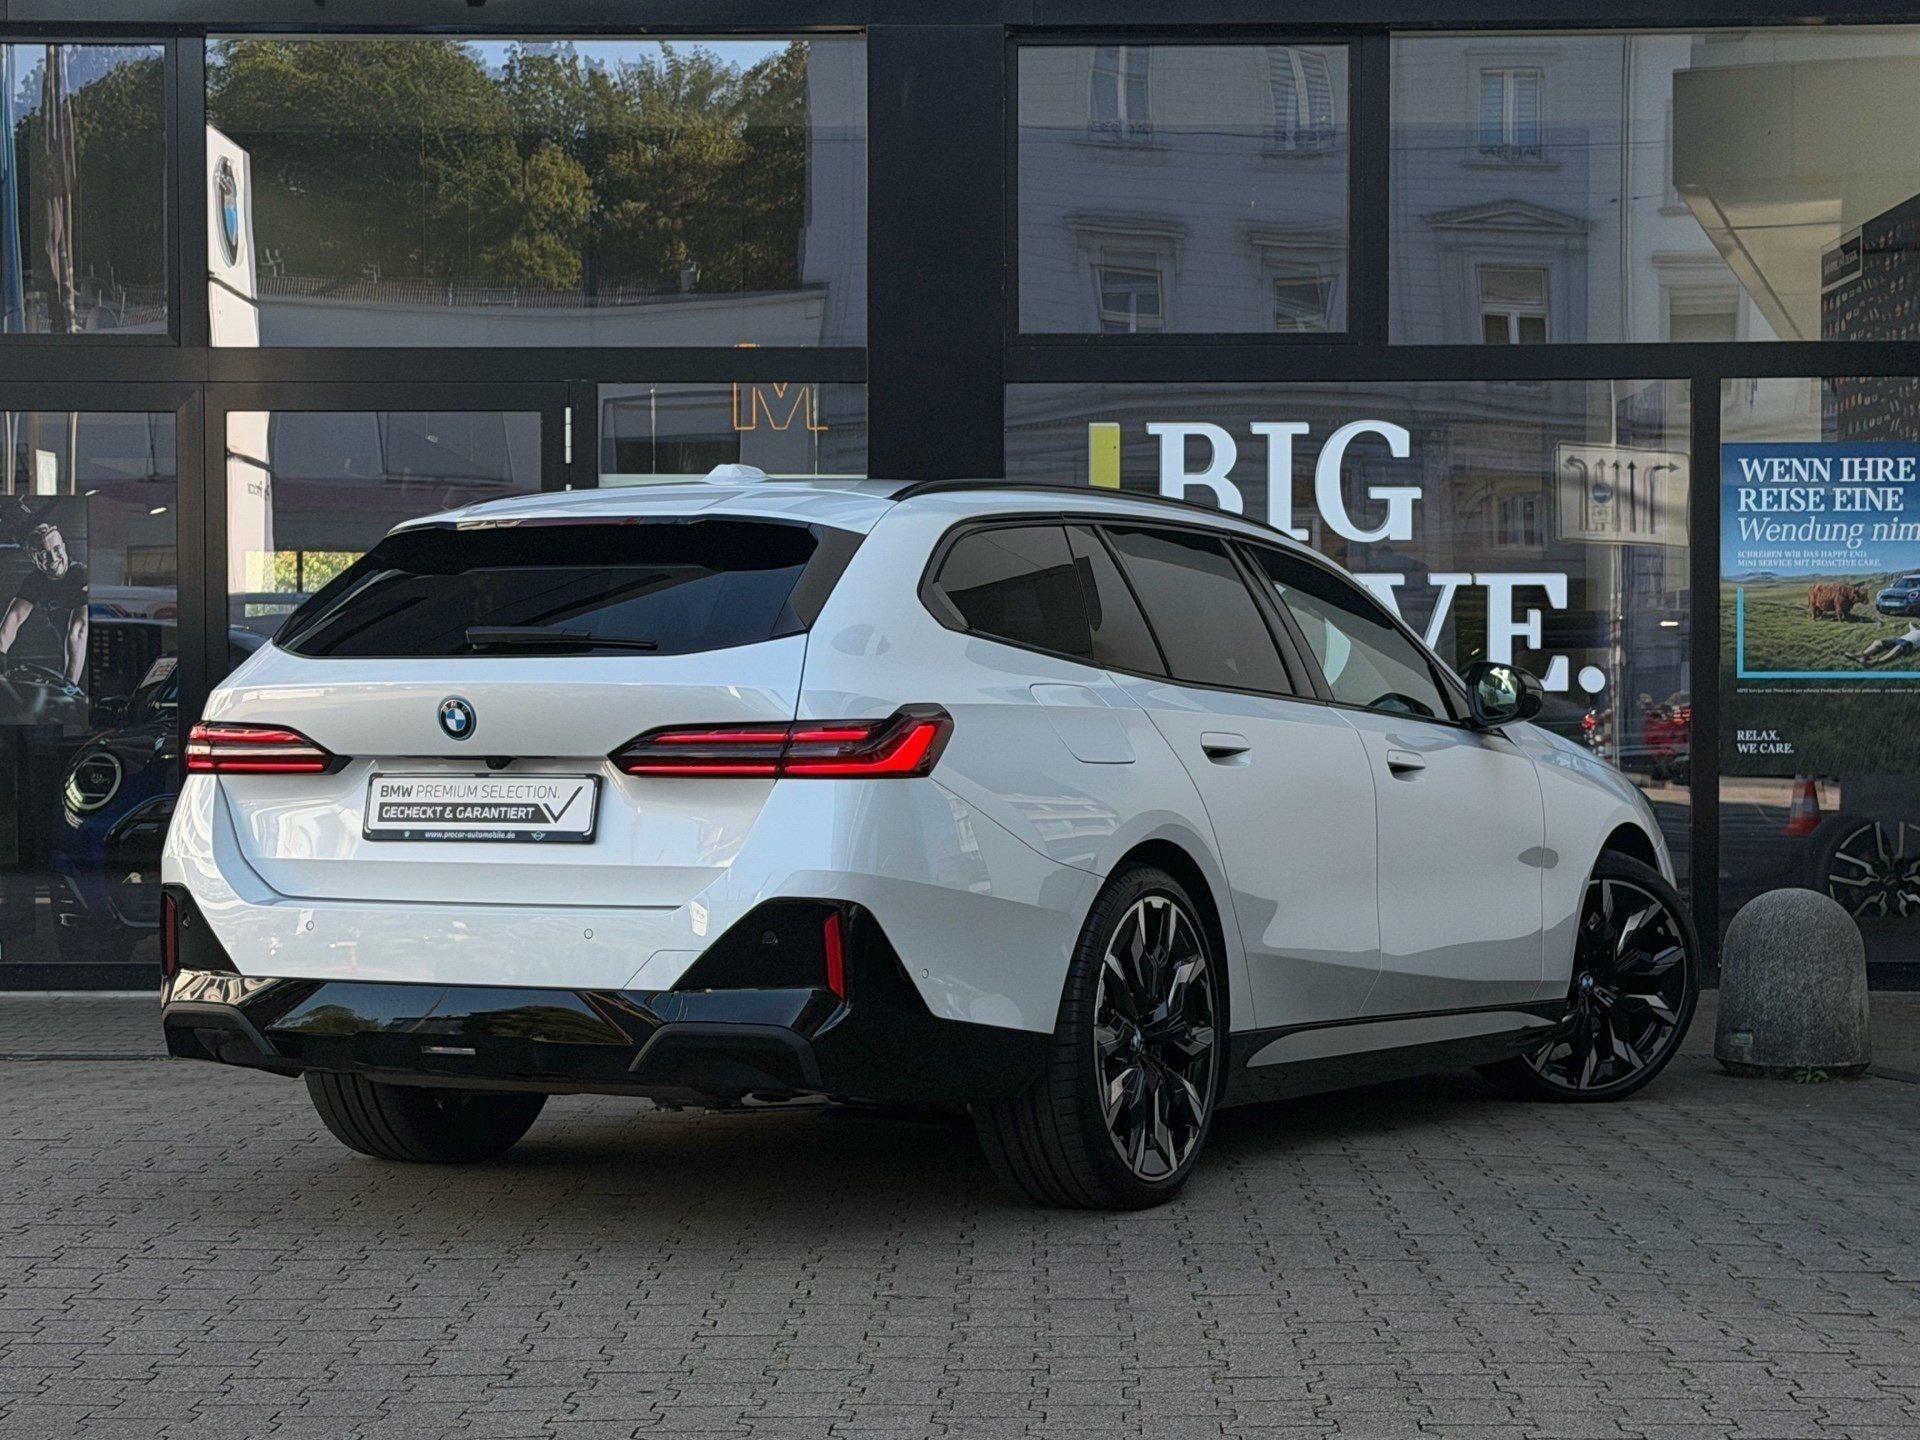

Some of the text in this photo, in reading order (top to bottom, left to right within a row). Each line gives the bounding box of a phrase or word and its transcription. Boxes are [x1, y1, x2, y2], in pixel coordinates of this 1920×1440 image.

[1737, 457, 1916, 483] WENN IHRE
[1146, 419, 1422, 543] BIG
[1737, 487, 1904, 512] REISE EINE
[1737, 515, 1865, 549] Wendung
[1820, 550, 1848, 559] HAPPY
[1736, 730, 1780, 741] RELAX.
[1736, 742, 1795, 754] WE CARE.
[380, 784, 560, 799] BMW PREMIUM SELECTION.
[381, 807, 536, 820] GECHECKT & GARANTIERT
